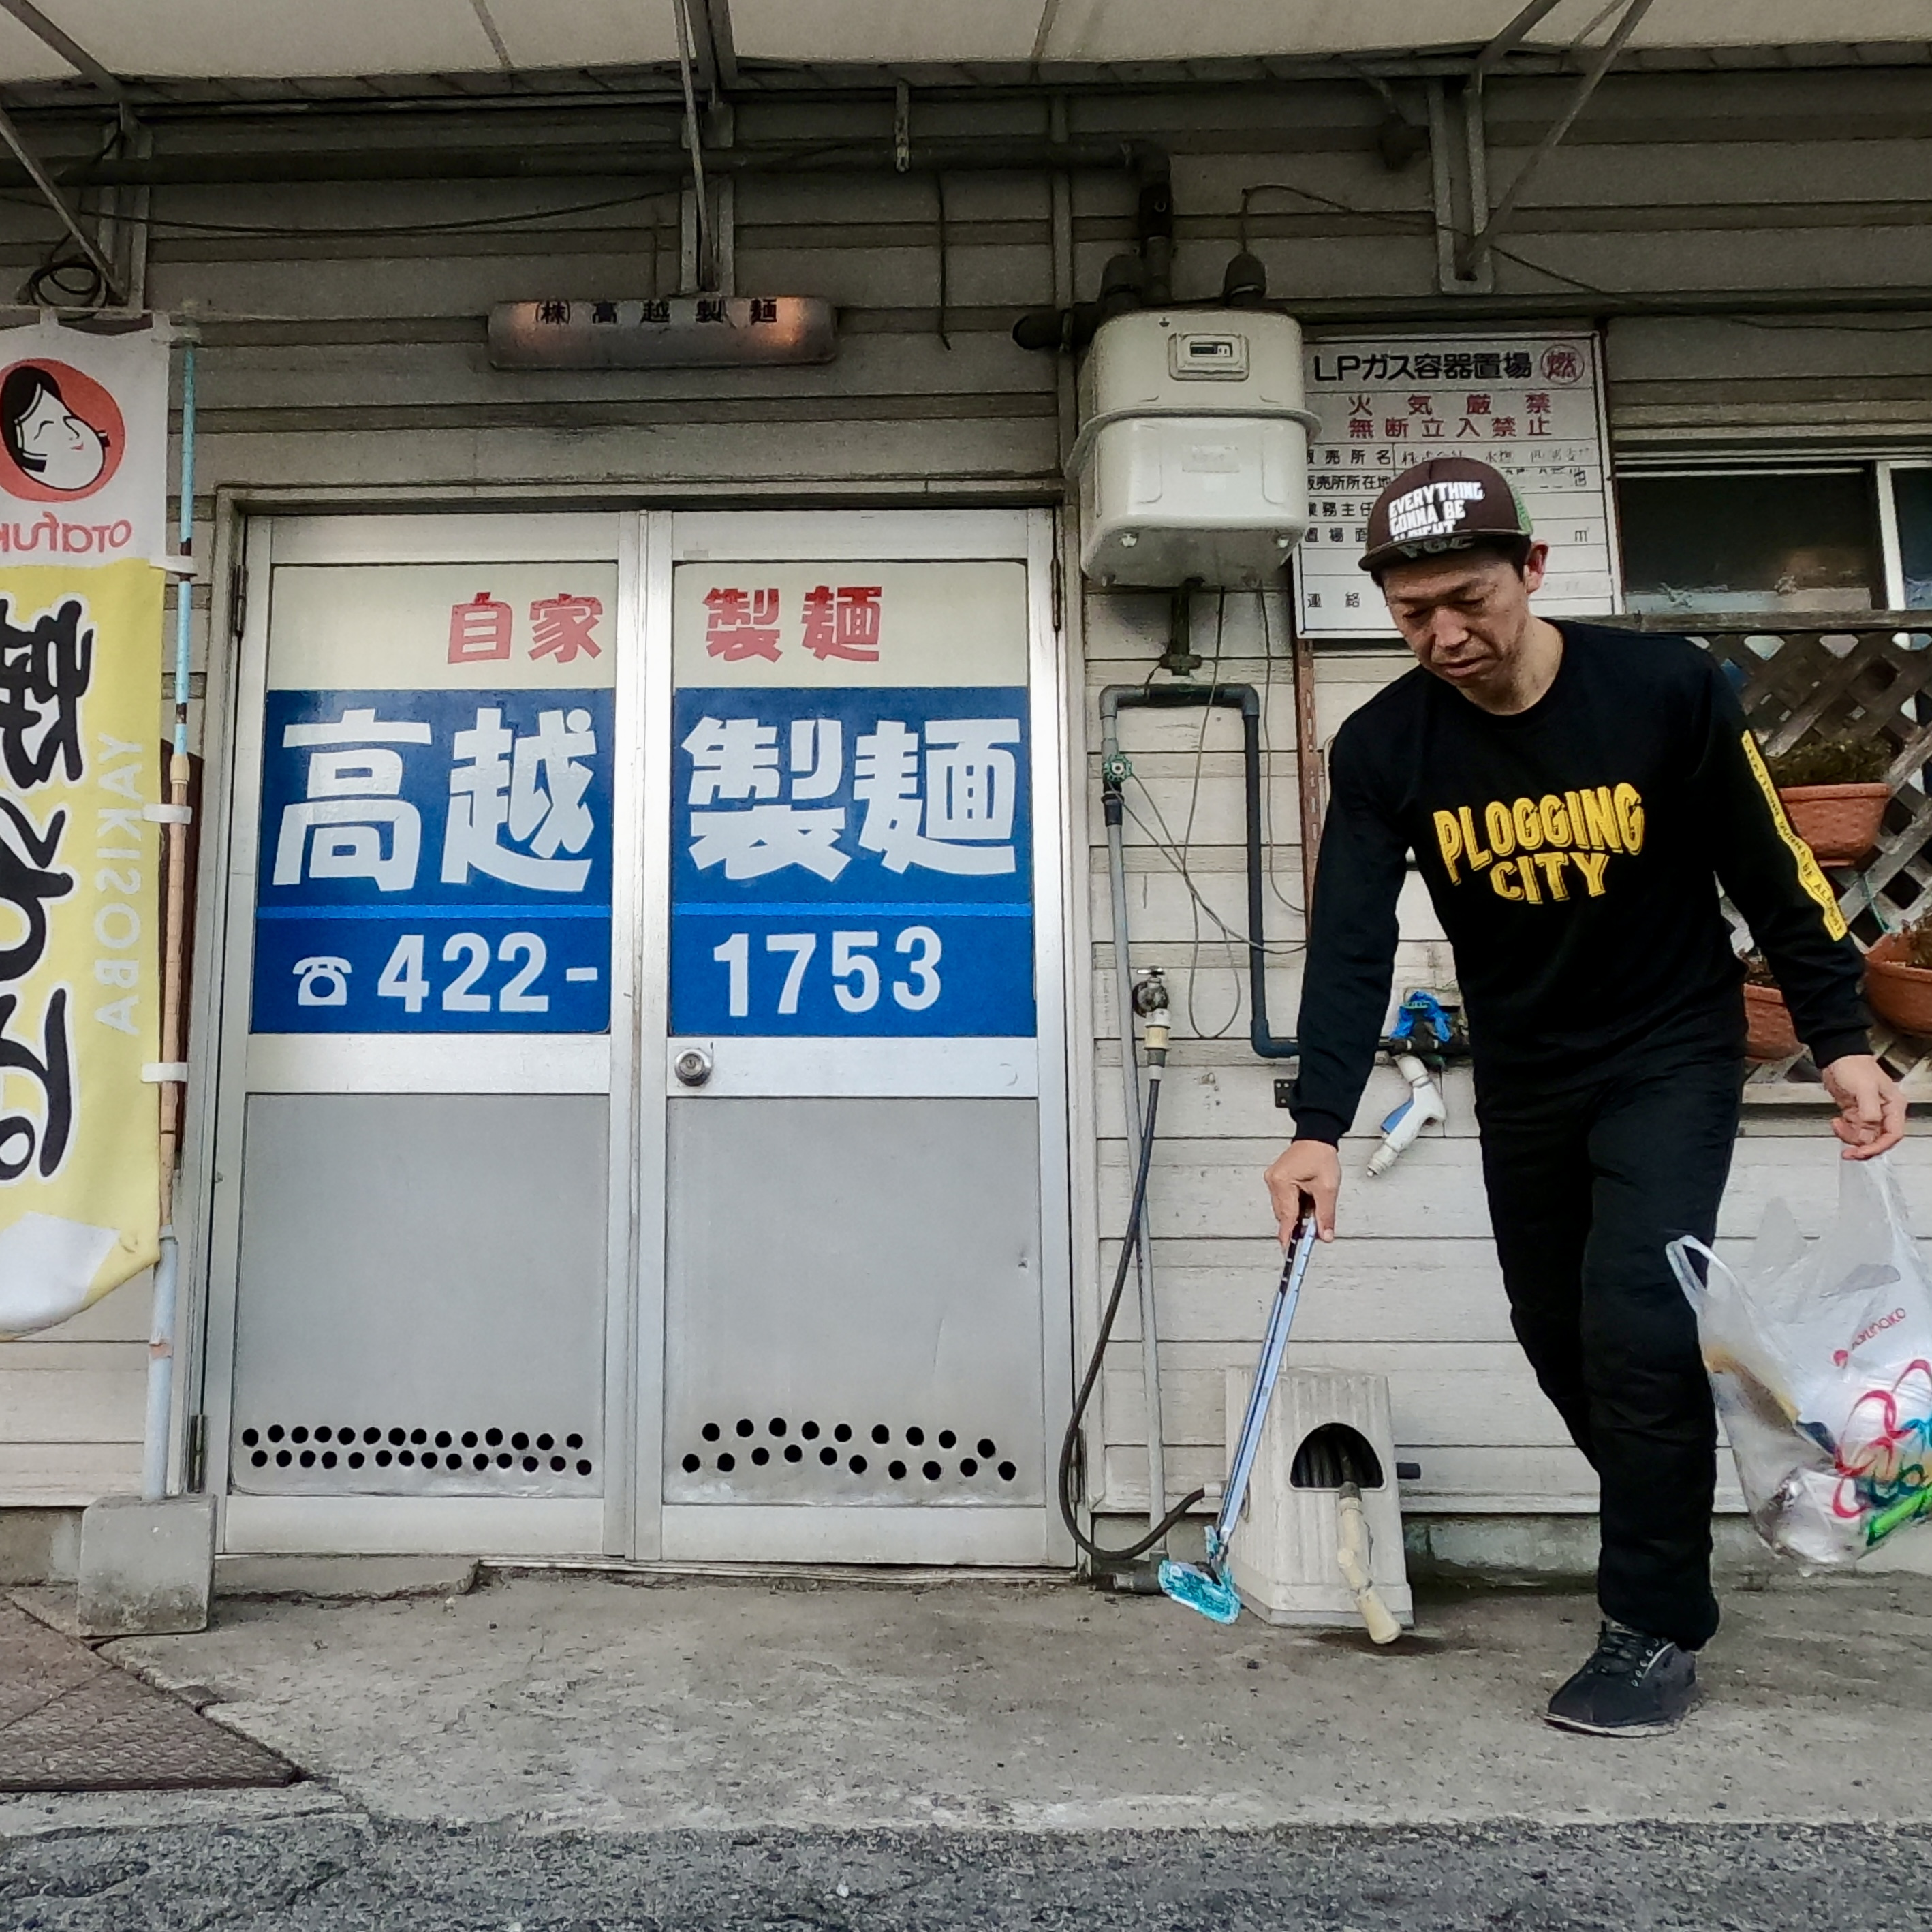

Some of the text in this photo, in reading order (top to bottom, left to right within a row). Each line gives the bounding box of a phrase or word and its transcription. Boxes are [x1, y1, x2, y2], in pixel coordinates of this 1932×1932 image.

[1314, 352, 1532, 381] LPガス容器置場
[1347, 393, 1551, 416] 火気厳禁
[1347, 417, 1553, 438] 無断立入禁止
[1388, 481, 1485, 519] EVERYTHING
[1389, 500, 1466, 537] GONNA BE
[446, 586, 883, 664] 自家 製麺
[272, 707, 1020, 892] 高越 製麺
[1433, 782, 1645, 886] PLOGGING
[1489, 852, 1610, 905] CITY
[713, 925, 942, 1018] 1753
